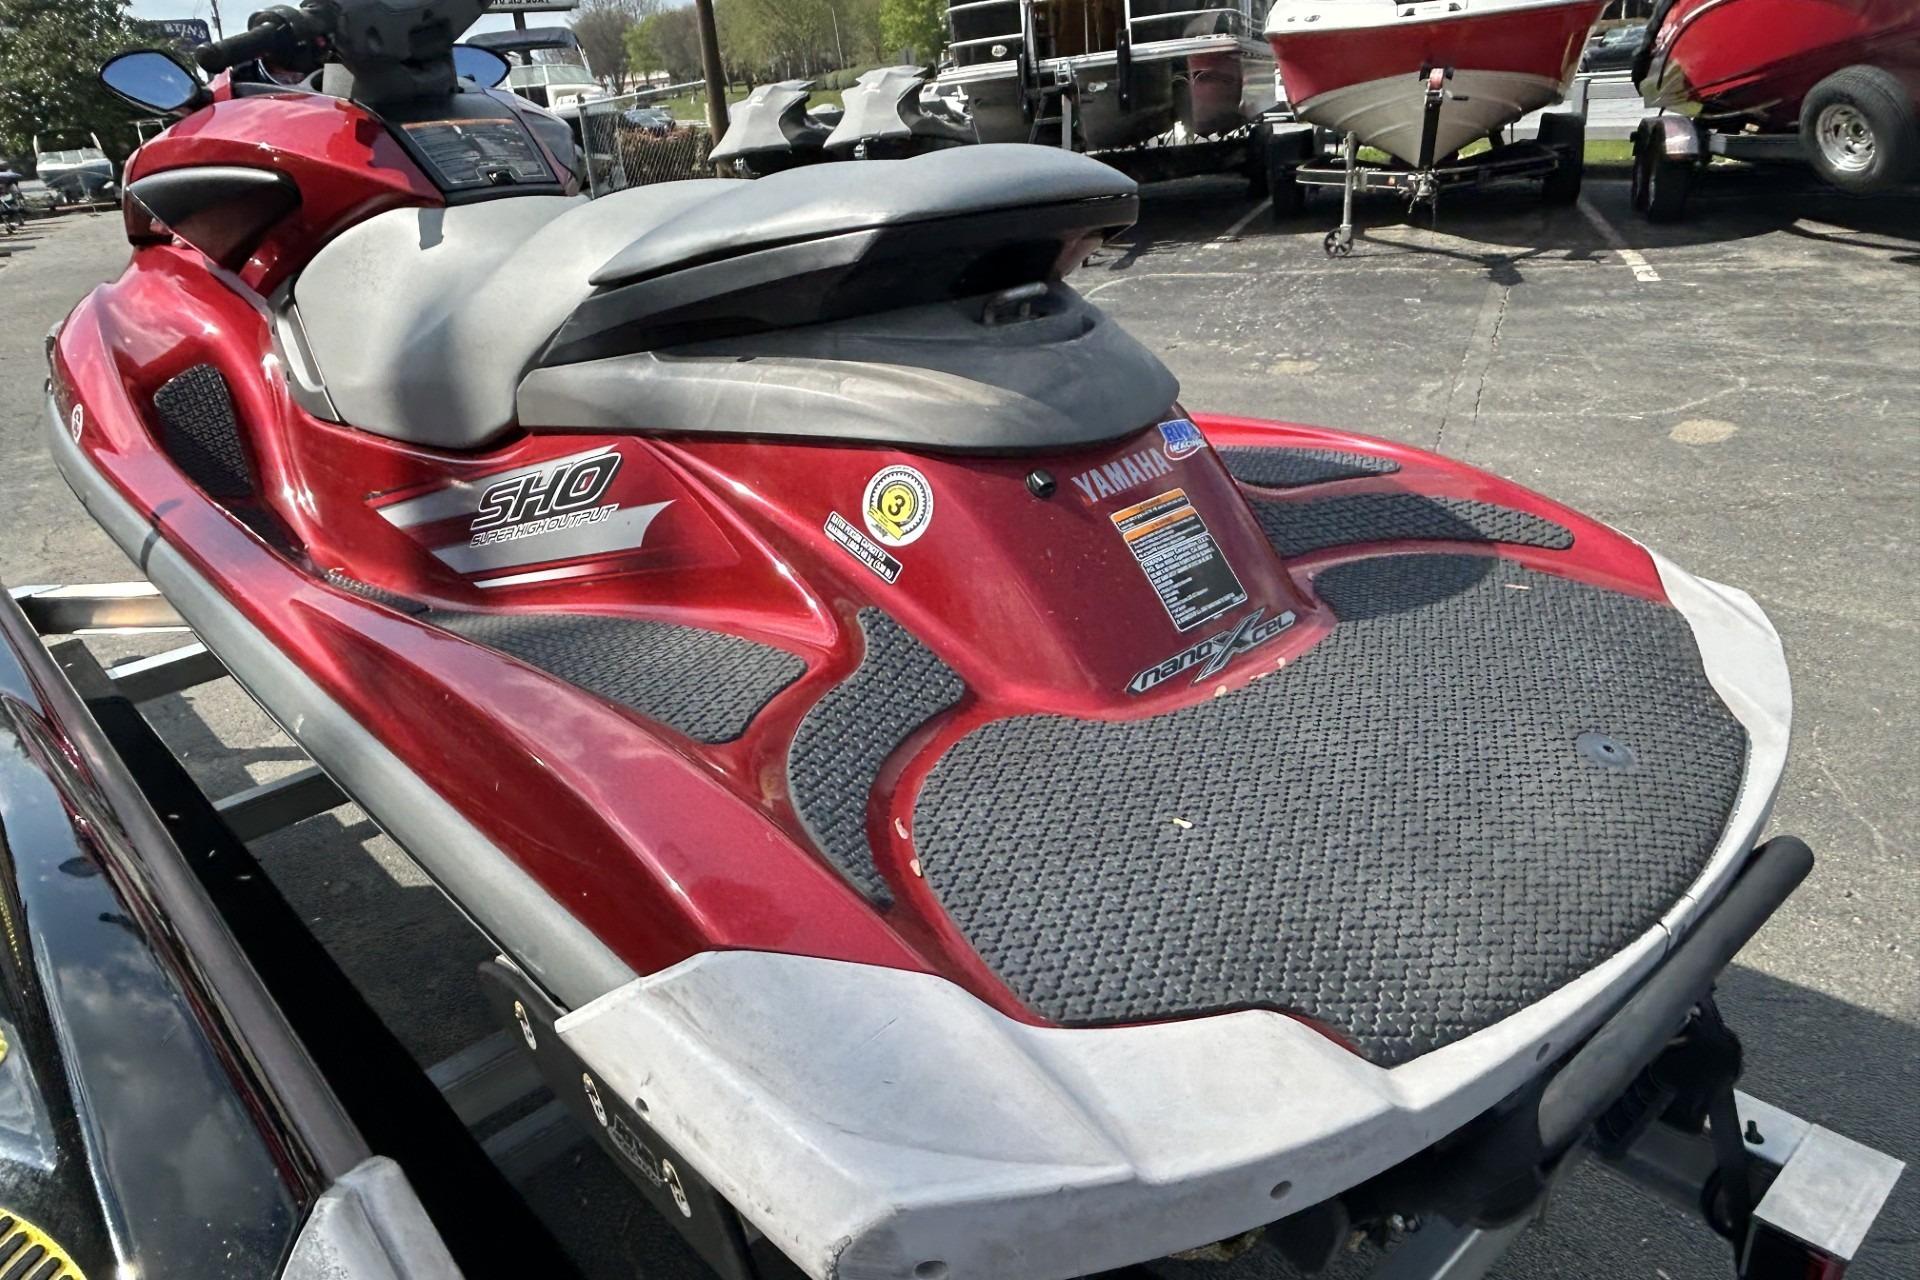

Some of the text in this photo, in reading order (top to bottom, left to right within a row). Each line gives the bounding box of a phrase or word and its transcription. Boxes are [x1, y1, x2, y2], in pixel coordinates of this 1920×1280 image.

[470, 452, 622, 530] SHO
[1071, 448, 1174, 503] YAMAHA
[888, 494, 906, 517] 3
